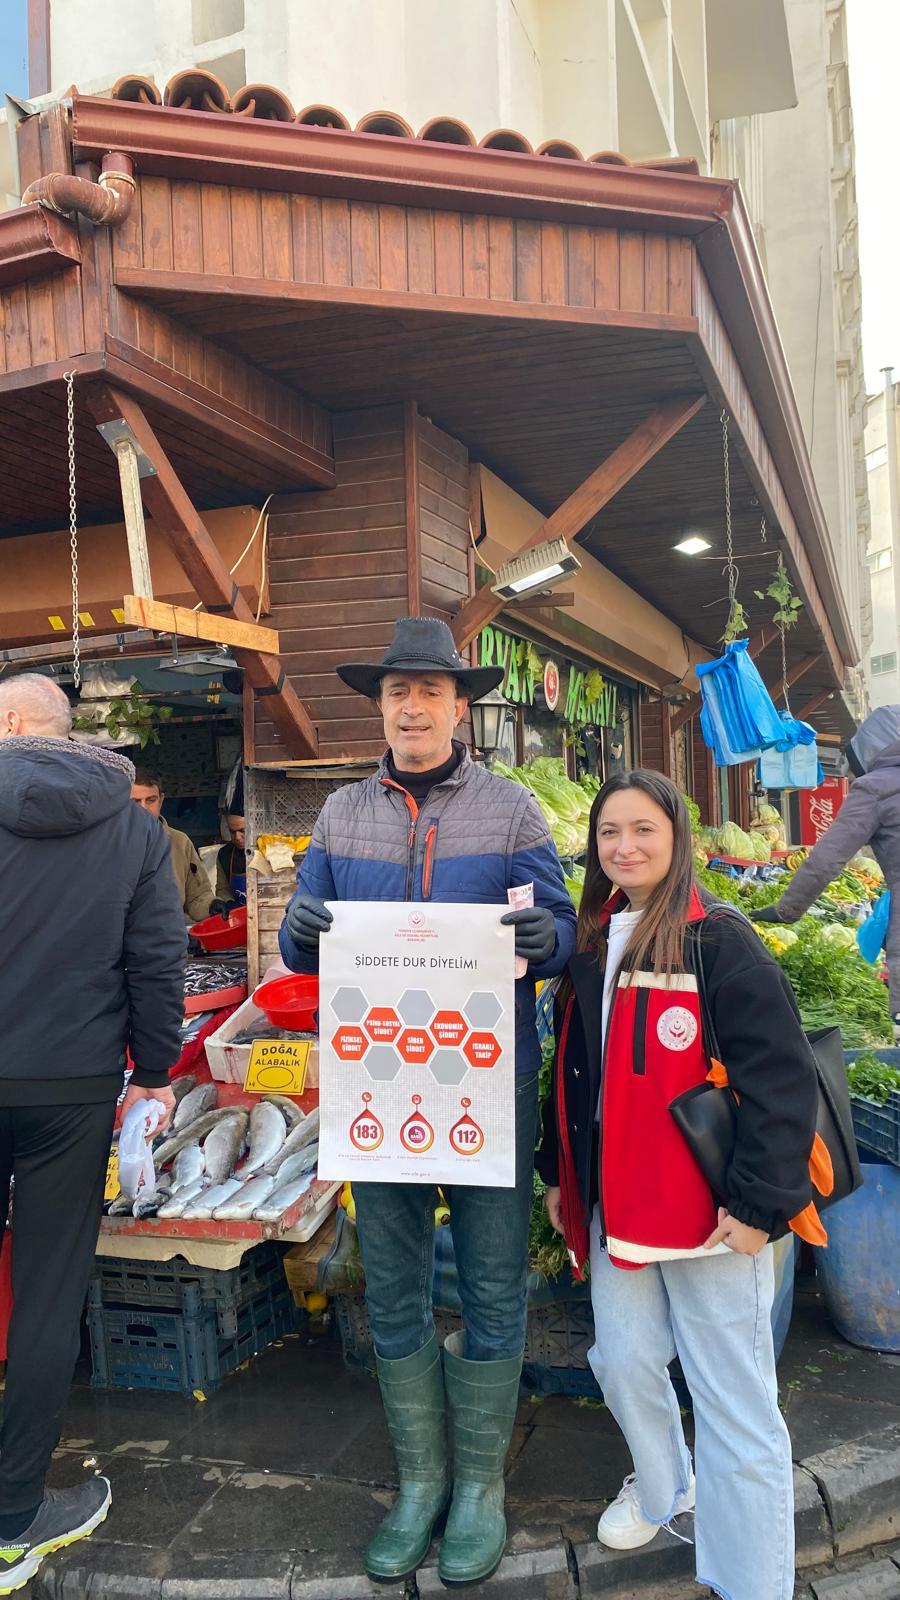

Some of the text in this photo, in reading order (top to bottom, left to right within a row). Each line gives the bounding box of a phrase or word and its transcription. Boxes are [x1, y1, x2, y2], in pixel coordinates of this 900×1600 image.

[355, 954, 478, 969] ŞİDDETE DUR DİYELİM!
[373, 1027, 393, 1035] ŞİDDET
[433, 1022, 463, 1031] EKONOMİK
[438, 1031, 458, 1039] ŞİDDET
[407, 1036, 424, 1044] SİBER
[261, 1044, 298, 1057] DOĞAL
[342, 1044, 361, 1052] ŞİDDET
[406, 1045, 425, 1053] ŞİDDET
[475, 1050, 492, 1059] TAKİP
[255, 1058, 301, 1067] ALABALIK
[356, 1125, 378, 1139] 183
[457, 1130, 477, 1144] 112
